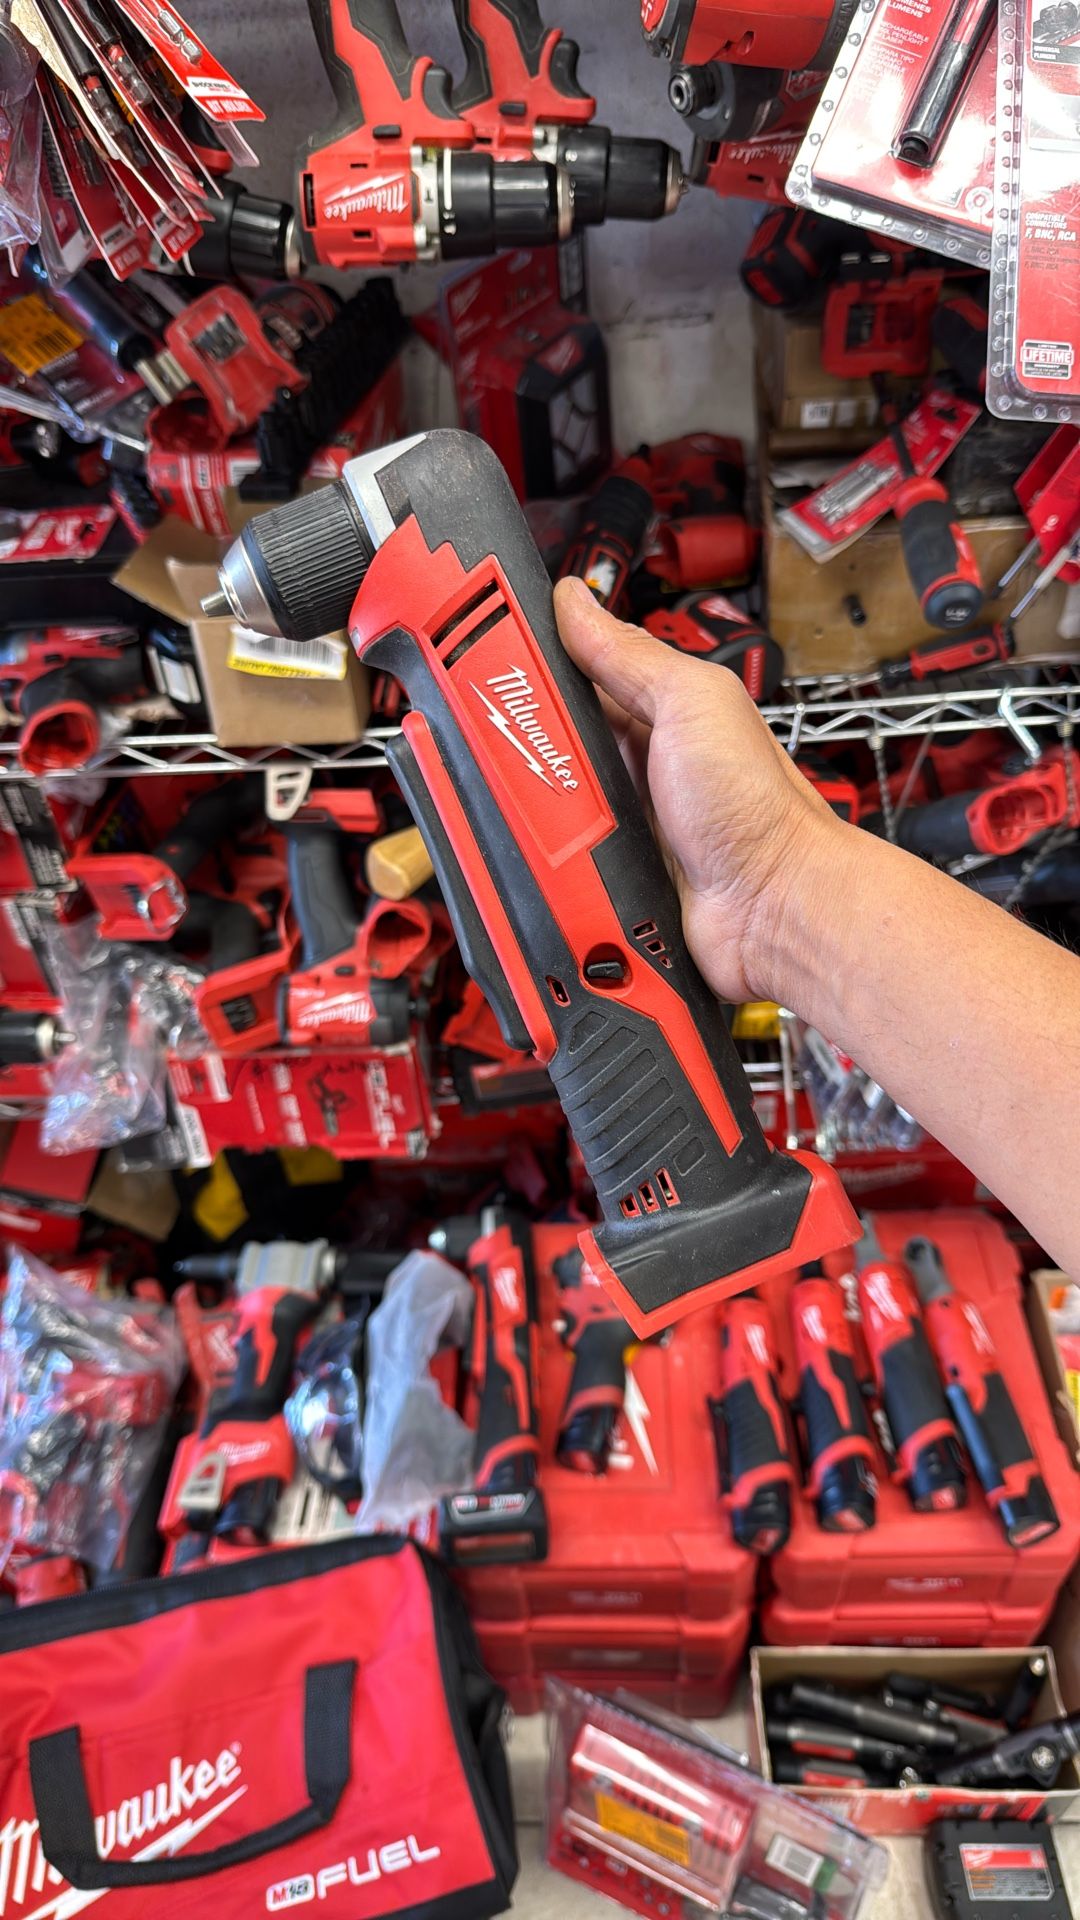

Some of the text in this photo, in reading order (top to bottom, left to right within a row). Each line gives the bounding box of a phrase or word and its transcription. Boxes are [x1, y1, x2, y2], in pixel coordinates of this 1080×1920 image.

[888, 1, 924, 18] LUMENS
[323, 181, 408, 221] Milwaukee
[1025, 220, 1068, 230] CONNECTORS
[1034, 229, 1056, 242] BNC,
[1057, 230, 1076, 242] RCA
[1022, 349, 1073, 364] LIFETIME
[486, 662, 579, 794] Milwaukee
[298, 1001, 371, 1029] Milwaukee
[0, 1748, 242, 1917] Mwaukee
[316, 1834, 441, 1900] FUEL
